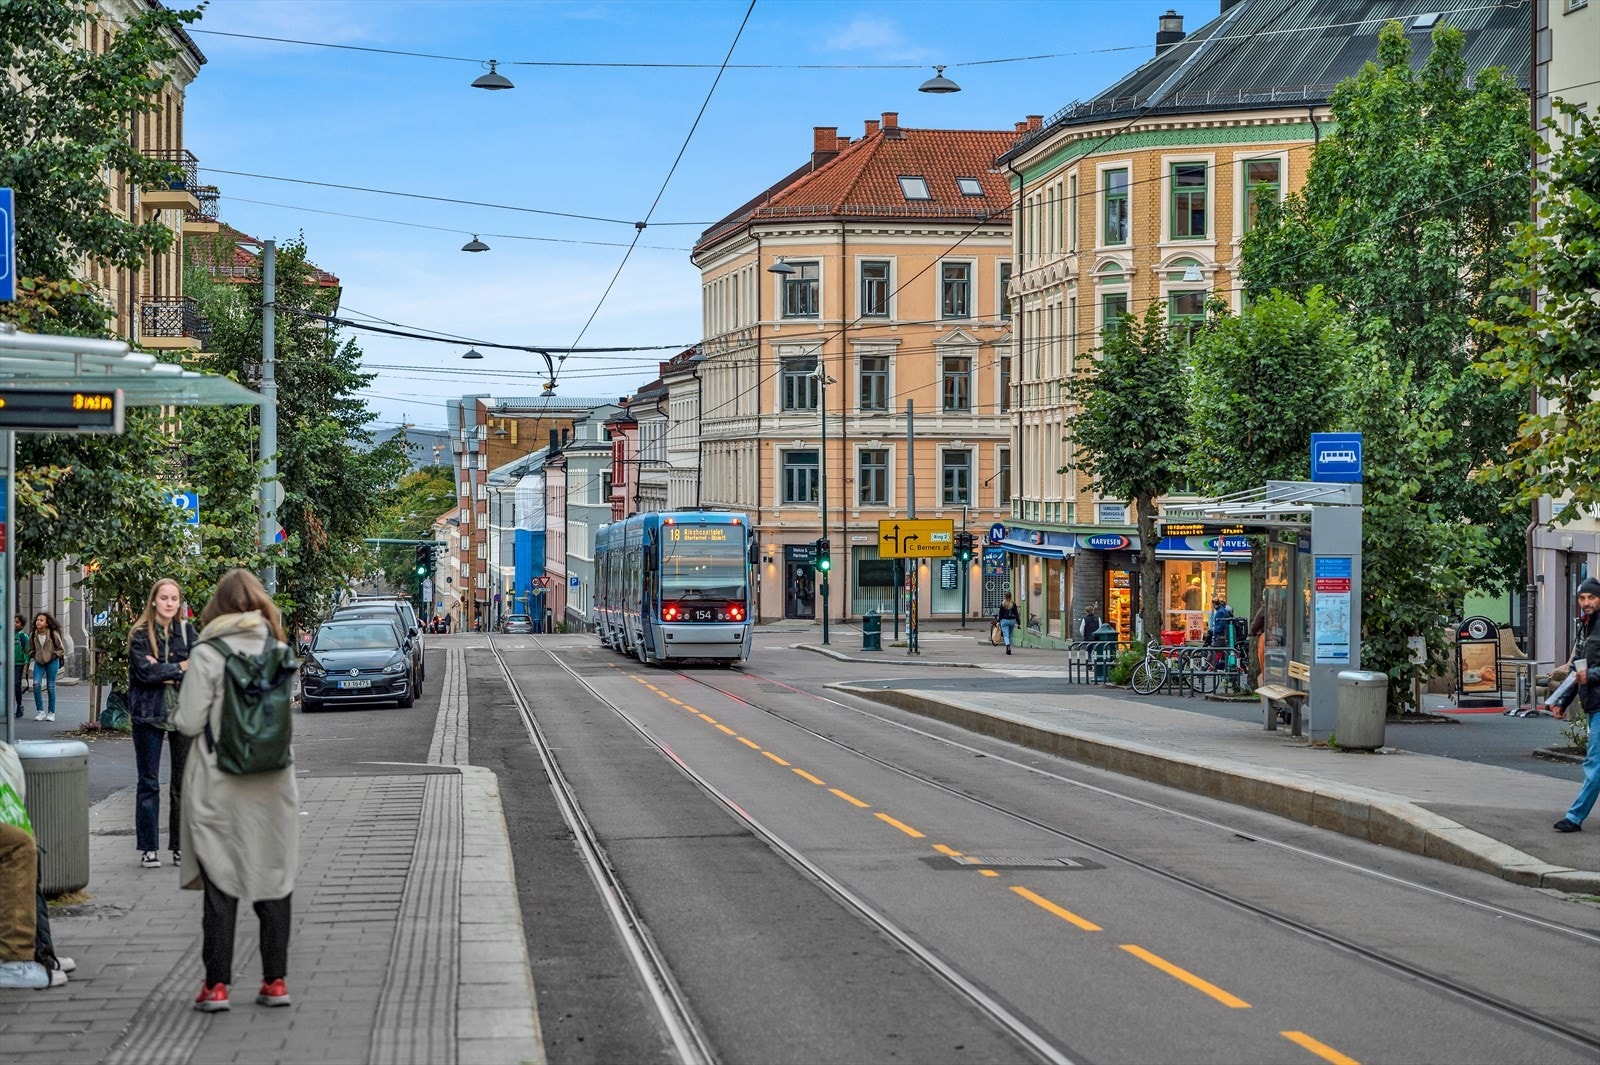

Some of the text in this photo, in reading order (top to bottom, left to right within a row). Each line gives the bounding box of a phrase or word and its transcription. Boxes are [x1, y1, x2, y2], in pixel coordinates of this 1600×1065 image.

[670, 528, 680, 540] 18
[992, 528, 1003, 539] N
[695, 610, 712, 619] 154
